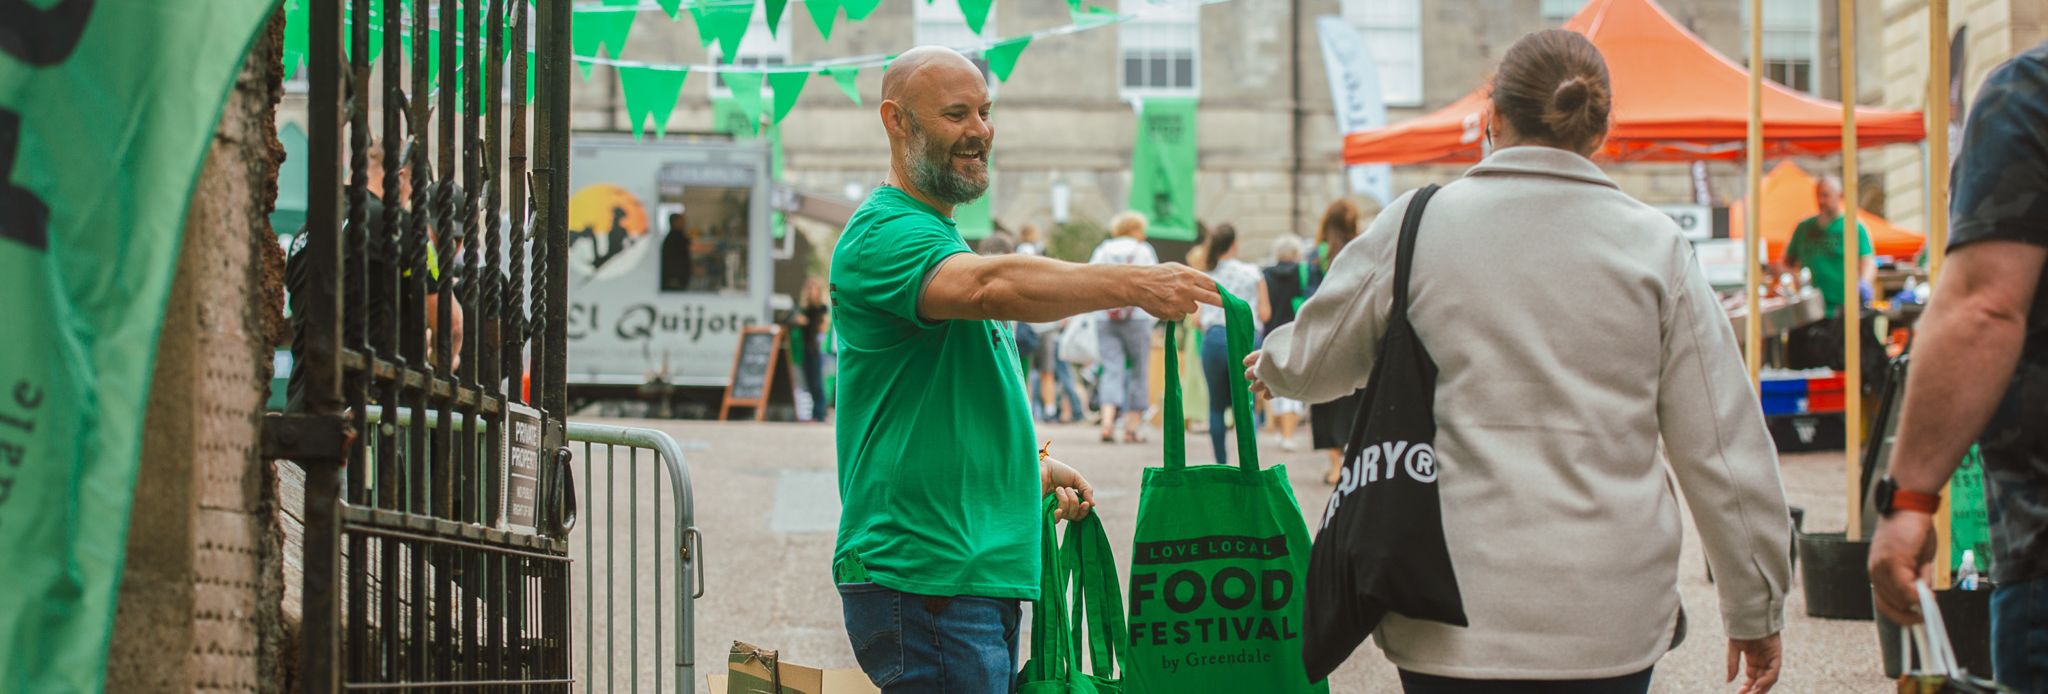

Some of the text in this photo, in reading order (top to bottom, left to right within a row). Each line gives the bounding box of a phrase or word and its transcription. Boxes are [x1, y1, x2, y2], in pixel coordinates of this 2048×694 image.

[568, 302, 598, 340] El
[1150, 540, 1272, 559] LOVE LOCAL
[1131, 566, 1294, 616] FOOD
[1130, 616, 1298, 647] FESTIVAL
[1162, 648, 1272, 674] by Greendale
